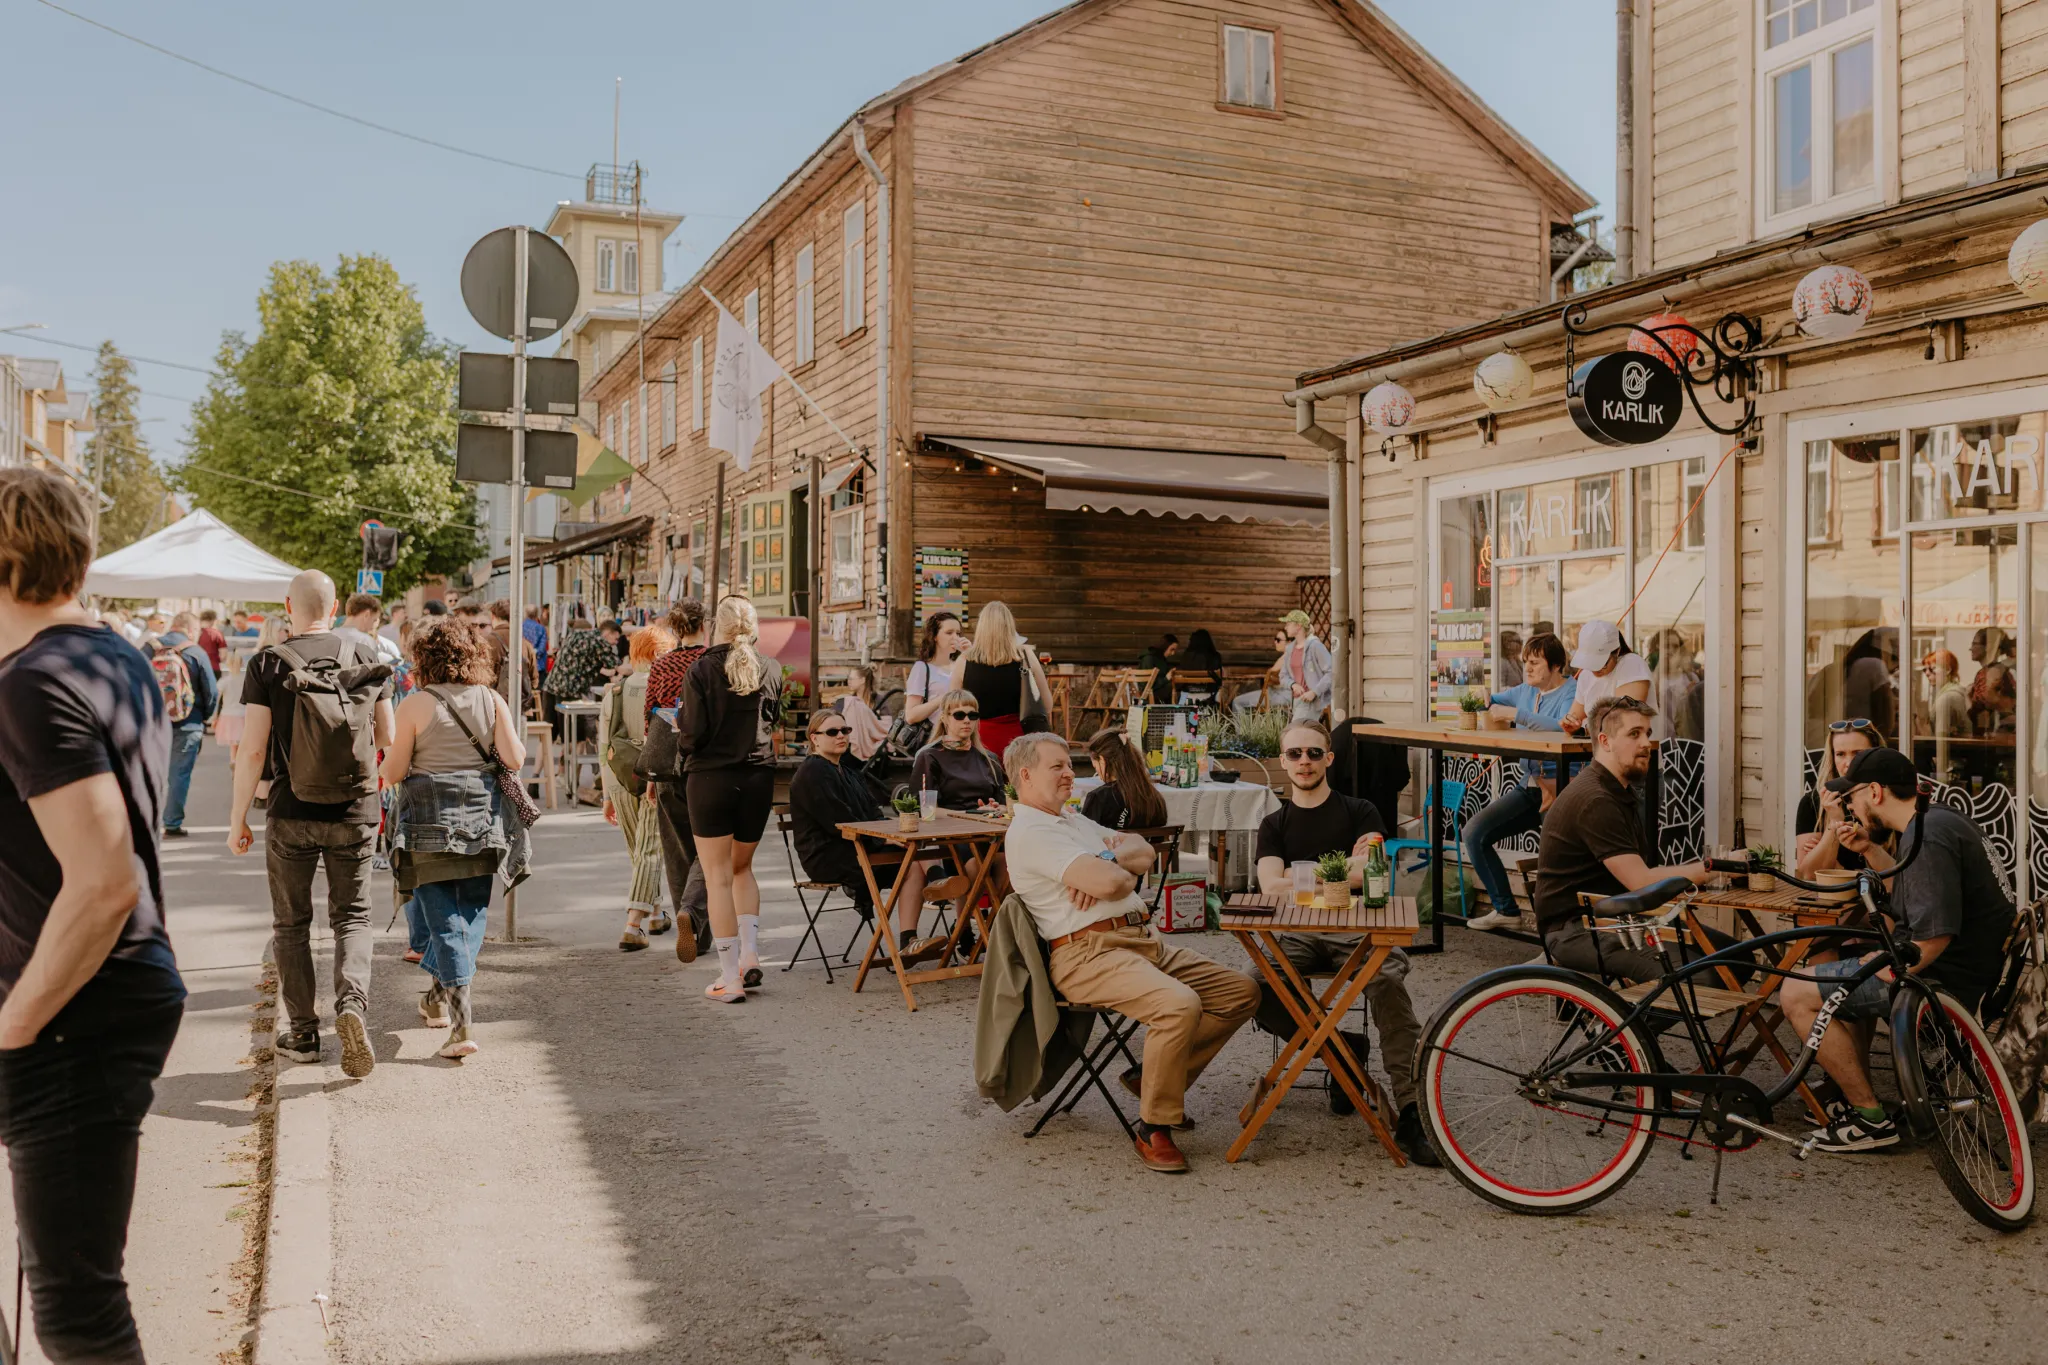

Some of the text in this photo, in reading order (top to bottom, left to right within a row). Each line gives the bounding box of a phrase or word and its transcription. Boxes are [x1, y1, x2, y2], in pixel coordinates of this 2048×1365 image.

[1602, 400, 1664, 425] KARLIK
[1934, 431, 2048, 500] KAR
[1509, 487, 1612, 543] KARLIK
